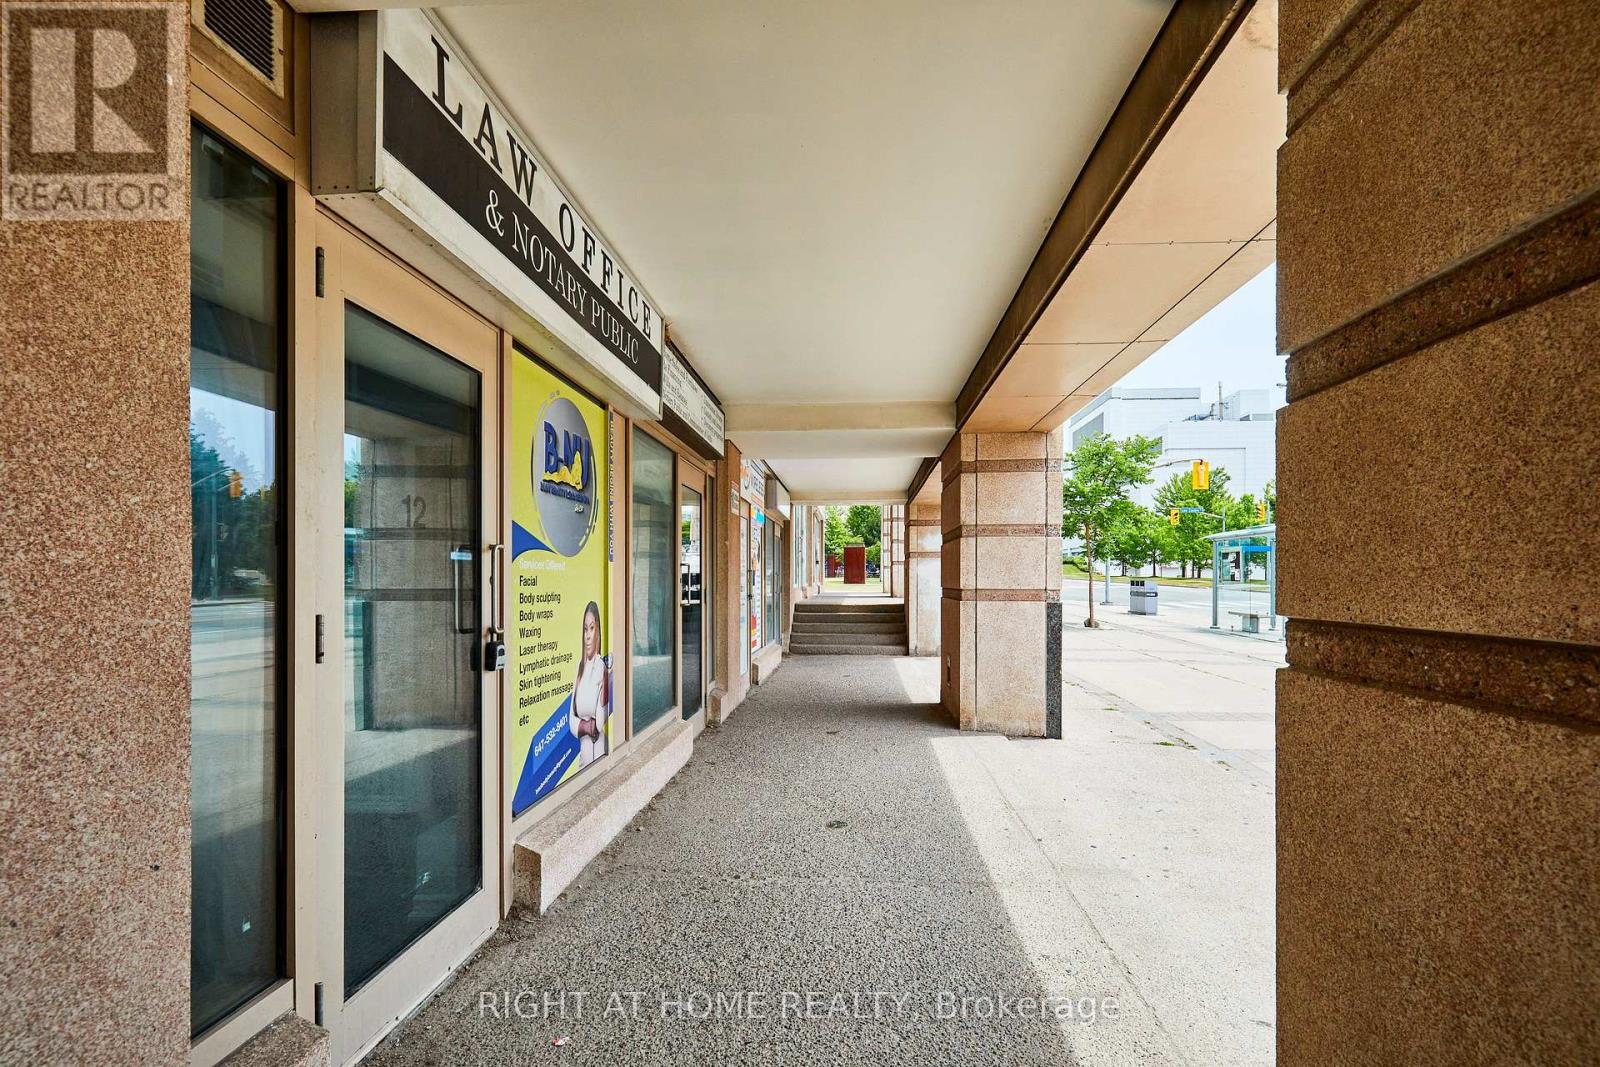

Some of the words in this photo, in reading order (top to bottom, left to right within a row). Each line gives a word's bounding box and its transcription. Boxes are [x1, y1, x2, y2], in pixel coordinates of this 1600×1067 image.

[431, 34, 537, 206] LAW
[558, 203, 651, 338] OFFICE
[485, 189, 504, 237] &
[512, 211, 587, 317] NOTARY
[590, 296, 639, 364] PUBLIC
[402, 494, 426, 528] 12
[519, 575, 538, 587] Facial
[519, 592, 535, 605] Body
[536, 592, 561, 604] sculpting
[519, 609, 535, 622] Body
[536, 609, 553, 620] wraps
[519, 626, 541, 638] Waxing
[519, 645, 536, 656] Laser
[537, 641, 558, 653] therapy
[519, 657, 549, 675] Lymphatic
[550, 652, 573, 665] drainage
[519, 678, 533, 692] Skin
[534, 671, 561, 687] tightening
[519, 690, 550, 709] Relaxation
[551, 682, 574, 696] massage
[518, 714, 529, 726] etc
